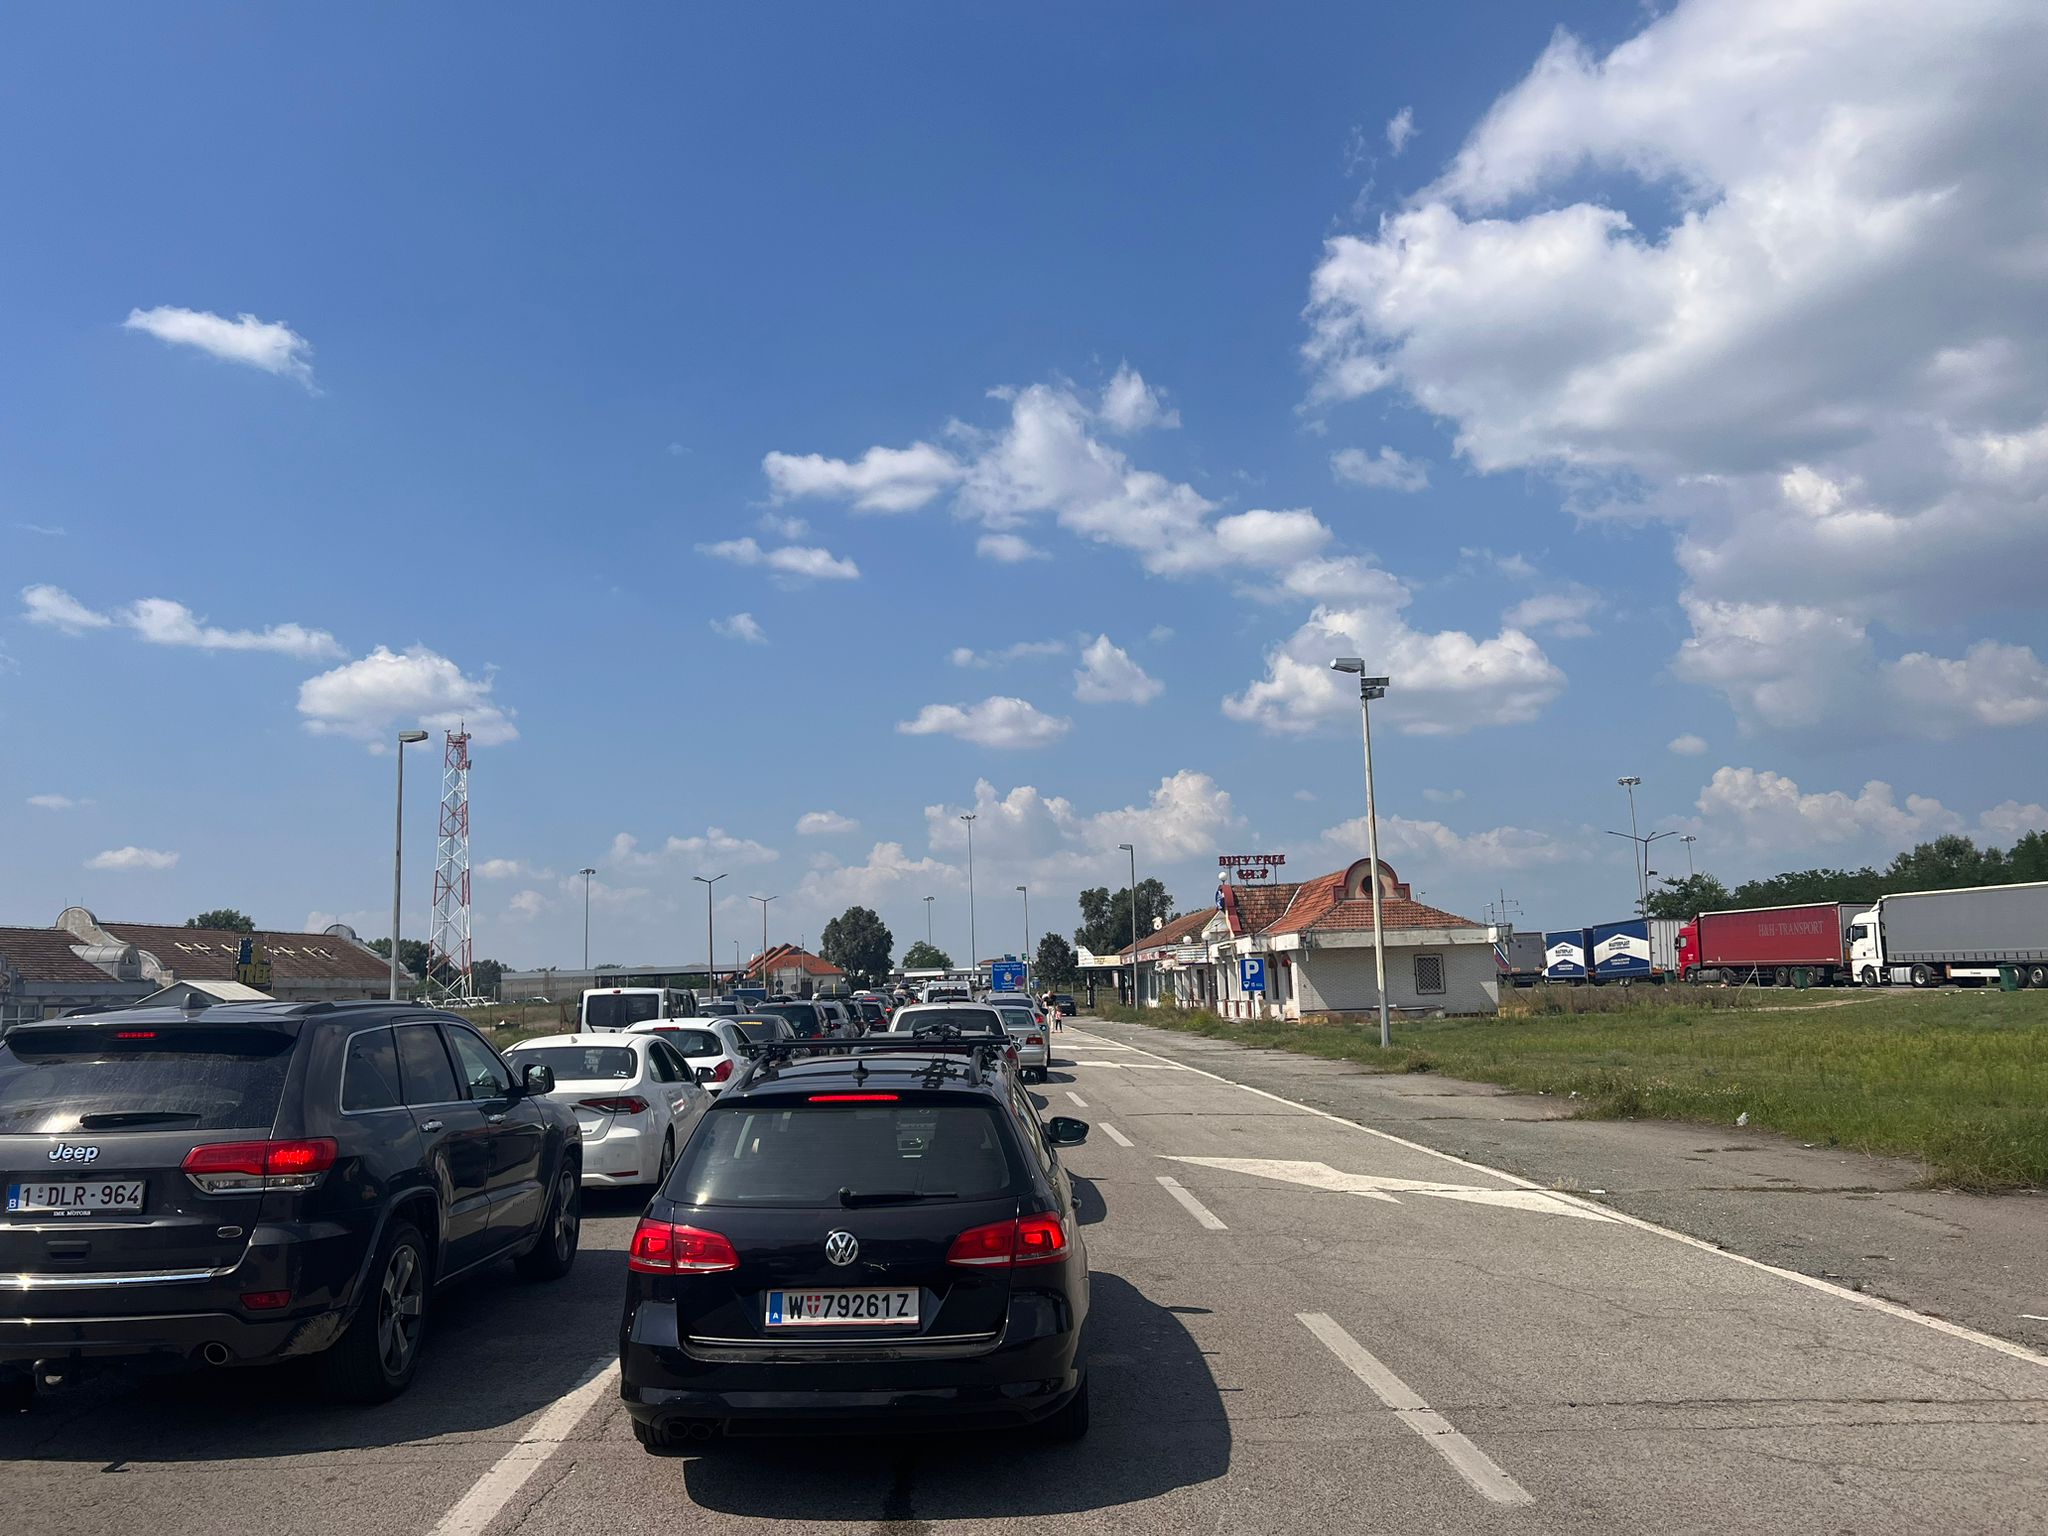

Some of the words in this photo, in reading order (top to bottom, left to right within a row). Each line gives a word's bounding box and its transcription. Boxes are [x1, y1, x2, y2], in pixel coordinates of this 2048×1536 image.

[1245, 960, 1260, 980] P
[49, 1143, 99, 1164] Jeep
[9, 1199, 17, 1208] B
[788, 1295, 804, 1319] W
